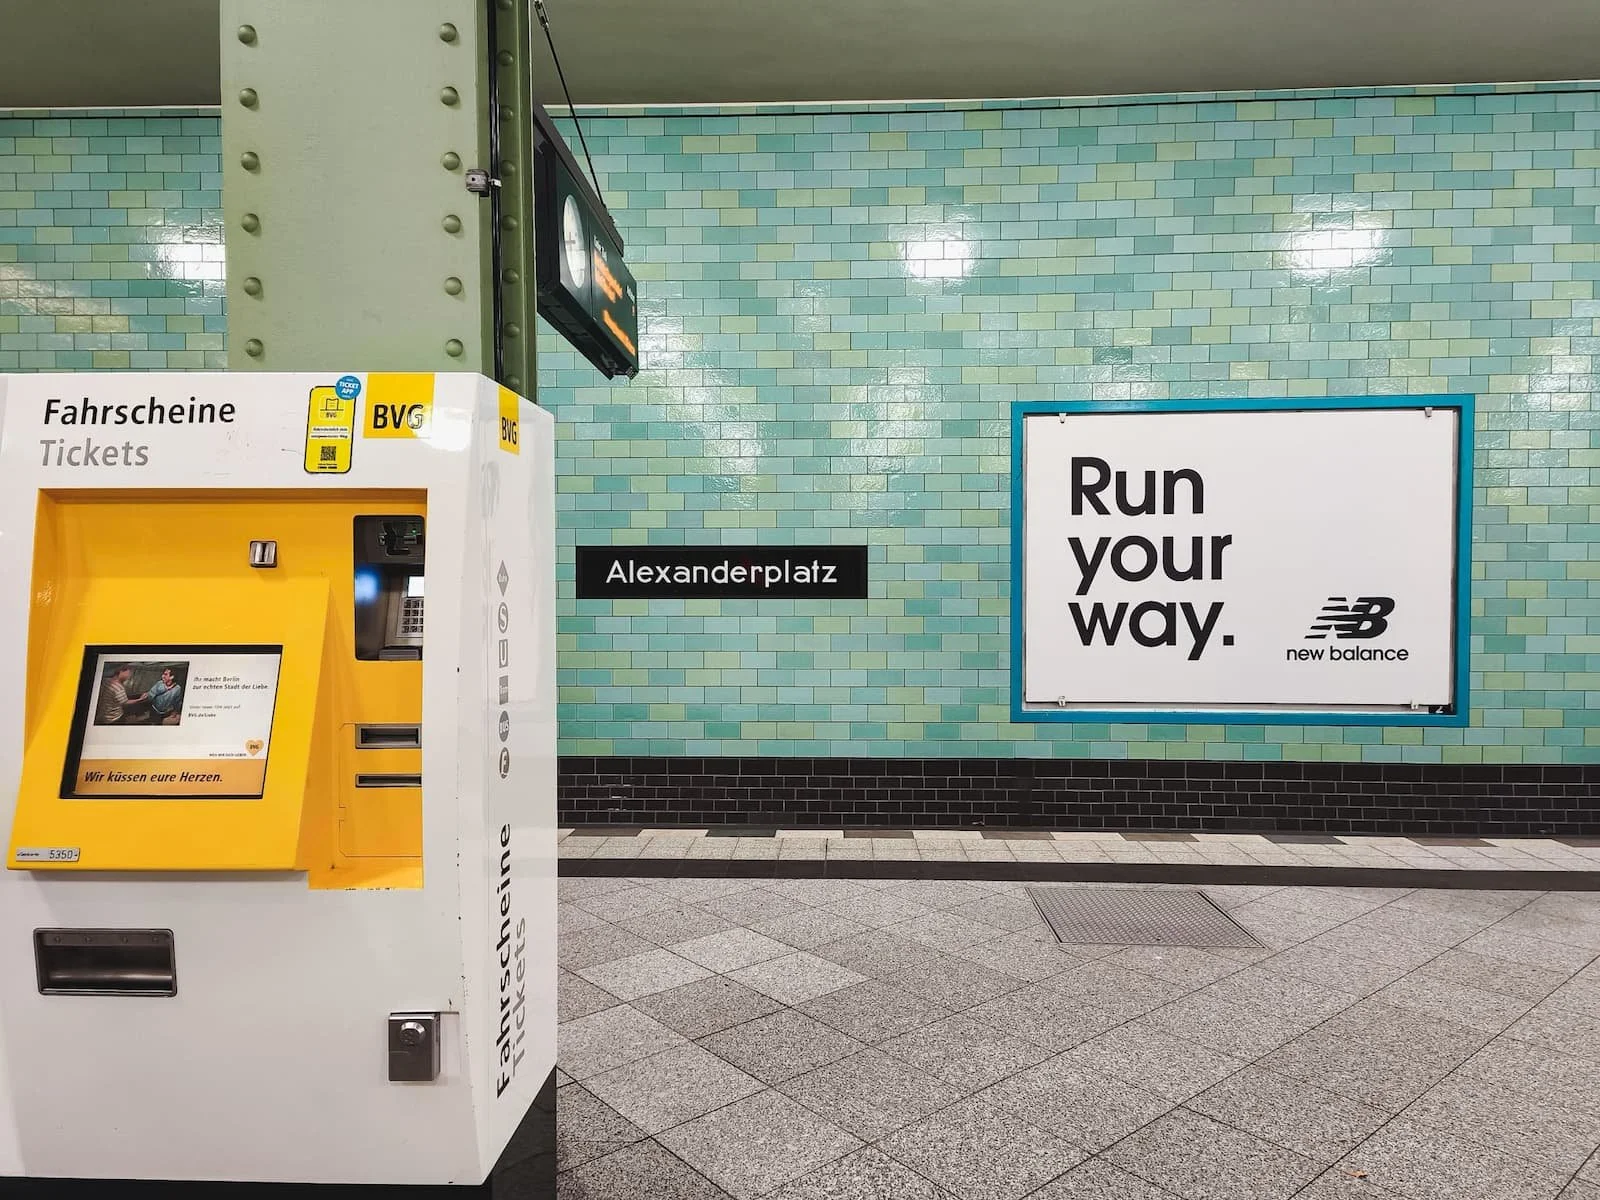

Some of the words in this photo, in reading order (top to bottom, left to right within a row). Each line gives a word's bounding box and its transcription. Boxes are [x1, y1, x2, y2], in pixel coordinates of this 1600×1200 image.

[339, 381, 360, 389] TICKET
[43, 396, 236, 425] Fahrscheine
[373, 404, 424, 429] BVG
[501, 416, 517, 445] BVG
[40, 437, 149, 467] Tickets
[1071, 456, 1205, 517] Run
[605, 559, 838, 588] Alexanderplatz
[1067, 534, 1233, 596] your
[1067, 600, 1235, 661] way.
[1286, 648, 1325, 661] new
[1329, 645, 1409, 661] balance
[84, 771, 105, 783] Wir
[106, 770, 148, 783] küssen
[150, 773, 177, 783] eure
[179, 771, 224, 783] Herzen.
[496, 823, 511, 1099] Fahrscheine
[512, 917, 526, 1077] Tickets
